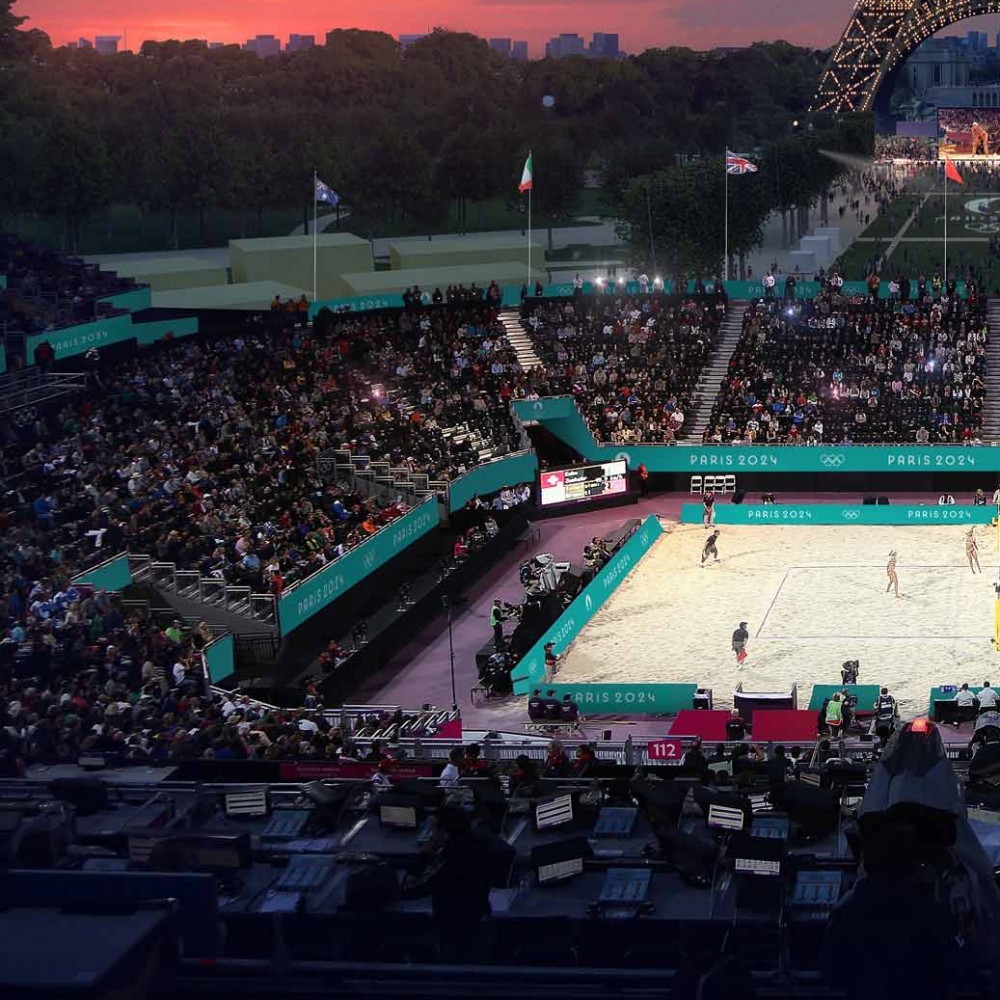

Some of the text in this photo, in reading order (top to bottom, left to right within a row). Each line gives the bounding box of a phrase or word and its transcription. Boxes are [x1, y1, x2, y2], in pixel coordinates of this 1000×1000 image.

[690, 454, 778, 466] PARIS 2024
[887, 454, 975, 466] PARIS 2024
[748, 510, 812, 519] PARIS 2024
[907, 510, 971, 519] PARIS 2024
[575, 692, 655, 703] ARIS 2024
[653, 743, 676, 756] 112
